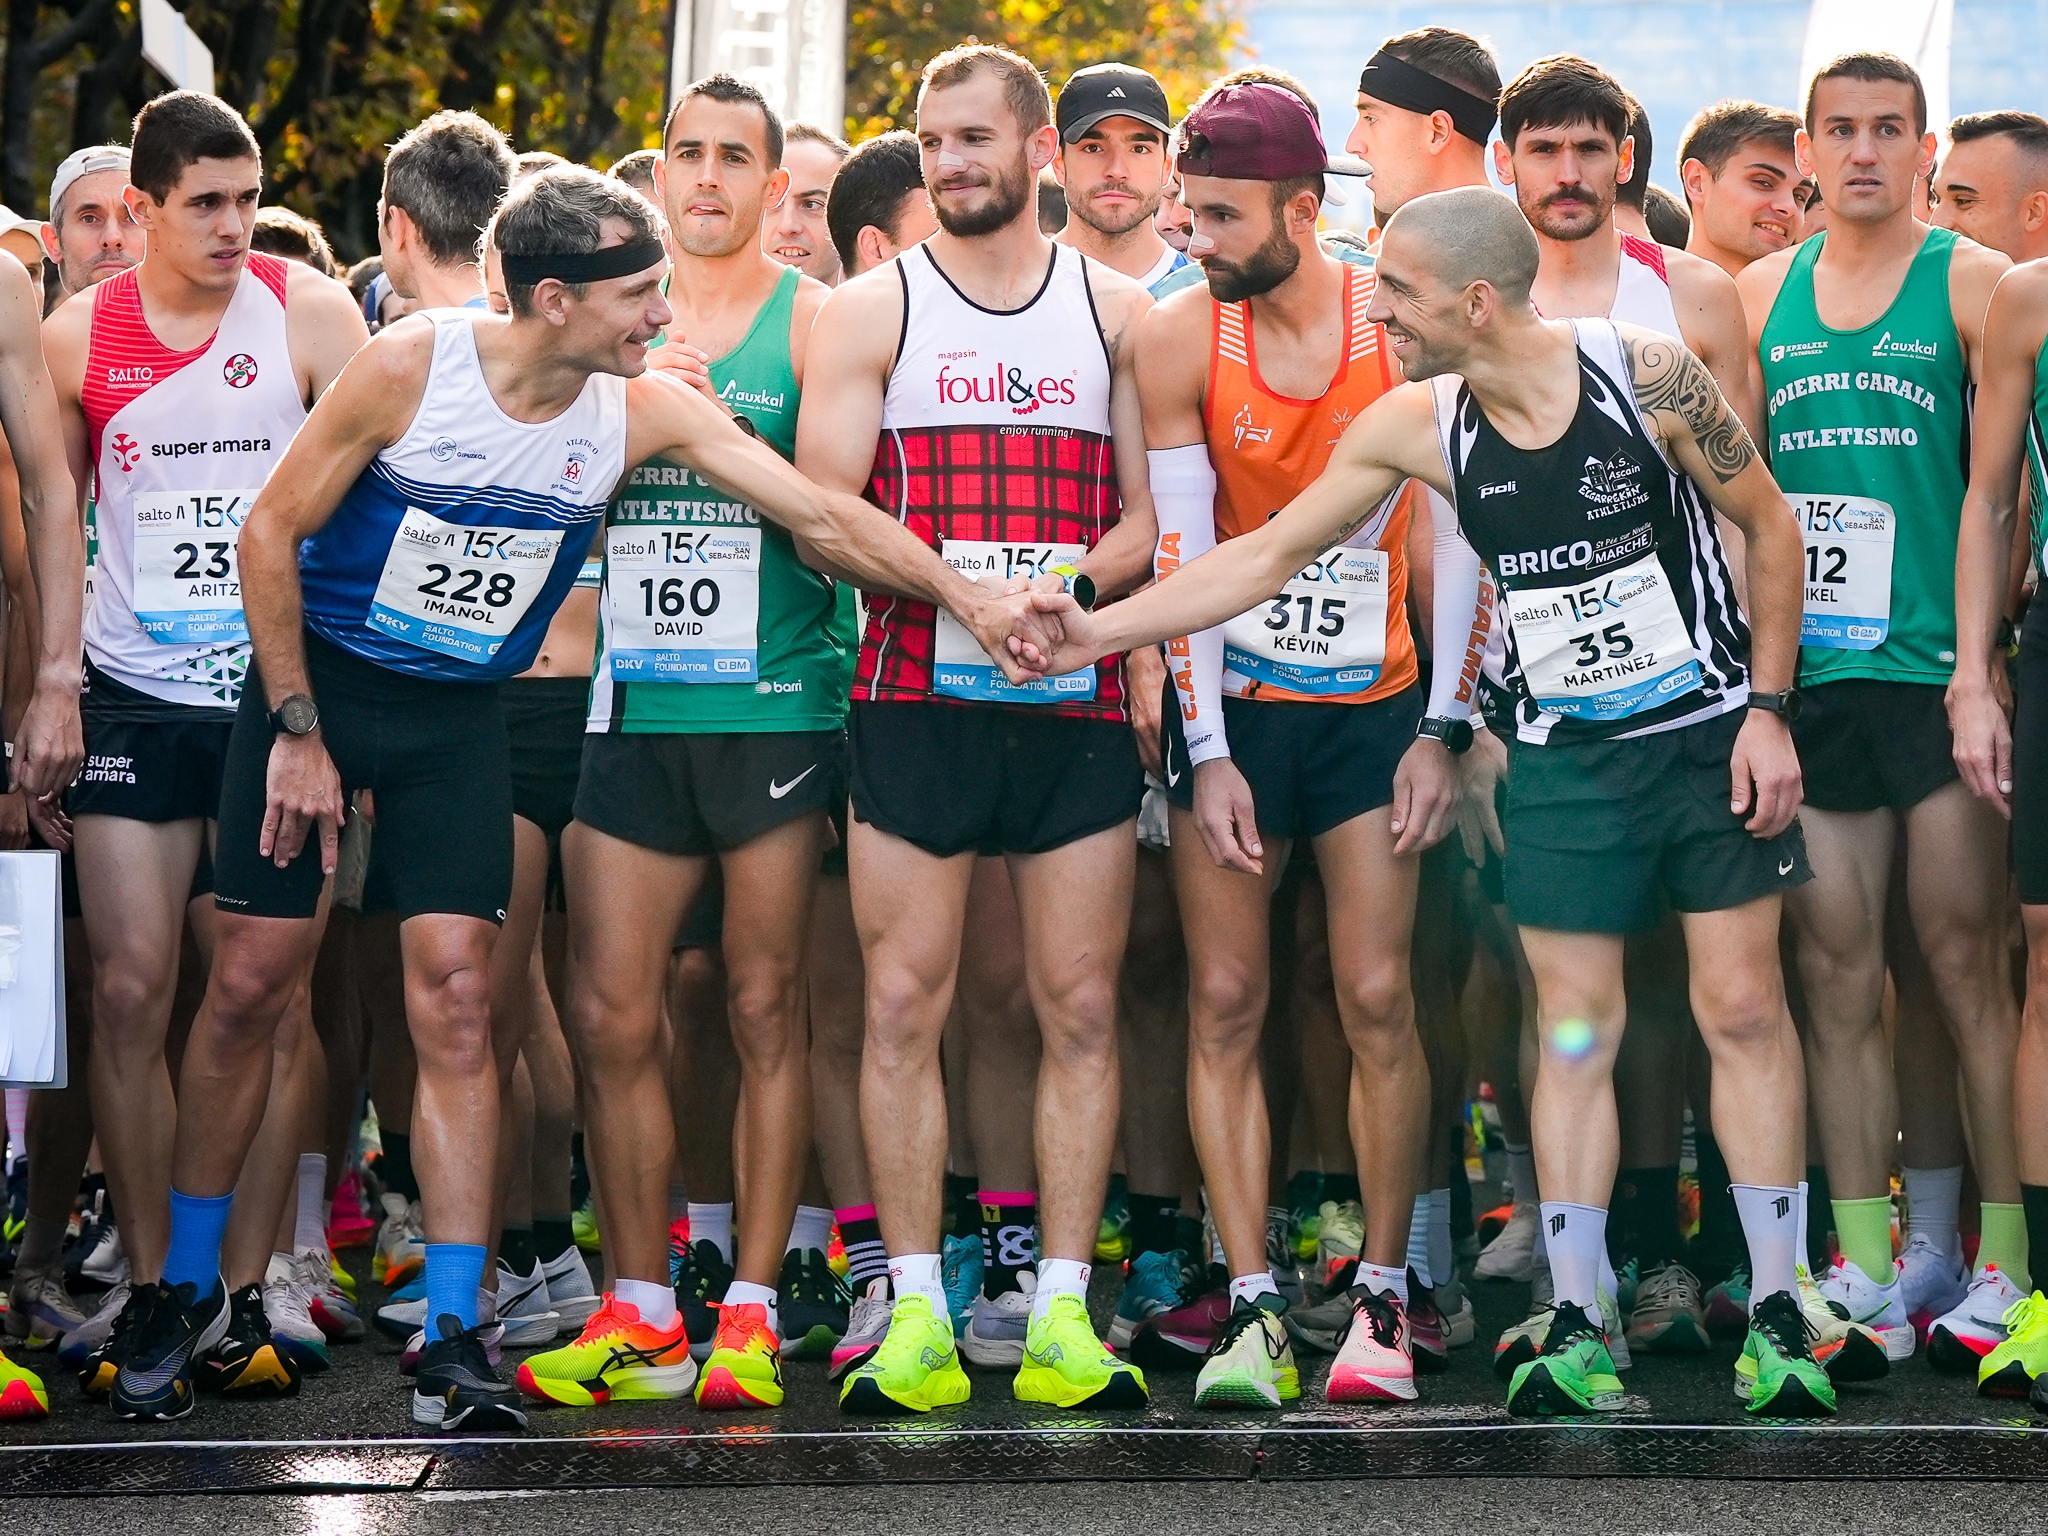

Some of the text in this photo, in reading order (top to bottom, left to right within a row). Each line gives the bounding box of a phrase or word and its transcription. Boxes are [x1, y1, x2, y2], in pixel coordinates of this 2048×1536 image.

[1891, 339, 1937, 356] auxkal
[937, 350, 977, 361] magasin
[108, 366, 153, 382] SALTO
[936, 363, 1076, 405] foul&es
[736, 389, 784, 408] auxkal
[1769, 371, 1936, 416] GOIERRI GARAIA
[1000, 425, 1029, 438] enjoy
[1778, 427, 1918, 453] ATLETISMO
[151, 438, 271, 459] super amara
[1607, 457, 1630, 470] A.S.
[1609, 465, 1640, 480] Ascain
[1480, 480, 1517, 499] poli
[138, 508, 171, 521] salto
[1844, 521, 1885, 530] SEBASTIAN
[402, 525, 440, 545] salto
[1620, 532, 1631, 541] sur
[515, 540, 552, 548] DONOSTIA
[612, 542, 644, 555] salto
[1595, 533, 1649, 564] MARCHE
[173, 542, 238, 579] 23
[508, 550, 549, 559] SEBASTIAN
[1498, 539, 1592, 577] BRICO
[945, 556, 981, 570] salto
[1344, 560, 1379, 569] DONOSTIA
[1806, 545, 1847, 584] 12
[417, 563, 516, 608] 228
[1340, 573, 1379, 583] SEBASTIAN
[1618, 568, 1653, 589] DONOSTIA
[1642, 575, 1656, 586] SAN
[188, 583, 240, 597] ARITZ
[640, 578, 720, 617] 160
[1157, 532, 1190, 657] BMA
[1618, 580, 1658, 602] SEBASTIAN
[1806, 587, 1838, 602] IKEL
[188, 613, 217, 622] SALTO
[424, 599, 495, 624] IMANOL
[1264, 593, 1346, 637] 315
[1514, 608, 1549, 622] salto
[188, 622, 245, 632] FOUNDATION
[375, 612, 410, 631] DKV
[655, 622, 703, 636] DAVID
[425, 624, 455, 636] SALTO
[422, 632, 482, 653] FOUNDATION
[1274, 634, 1329, 655] KÉVIN
[1454, 581, 1494, 704] BALMA
[1569, 621, 1634, 667] 35
[615, 659, 644, 670] DKV
[656, 653, 680, 661] SALTO
[1226, 651, 1260, 668] DKV
[654, 663, 708, 672] FOUNDATION
[729, 661, 747, 670] BM
[1273, 662, 1301, 675] SALTO
[1563, 652, 1657, 688] MARTINEZ
[940, 674, 976, 686] DKV
[1273, 669, 1329, 685] FOUNDATION
[1352, 670, 1369, 679] BM
[1673, 672, 1690, 686] BM
[773, 679, 802, 693] barri
[1070, 681, 1086, 689] BM
[1594, 691, 1653, 711] FOUNDATION
[1548, 704, 1580, 714] DKV
[88, 755, 133, 770] super
[85, 769, 136, 784] amara
